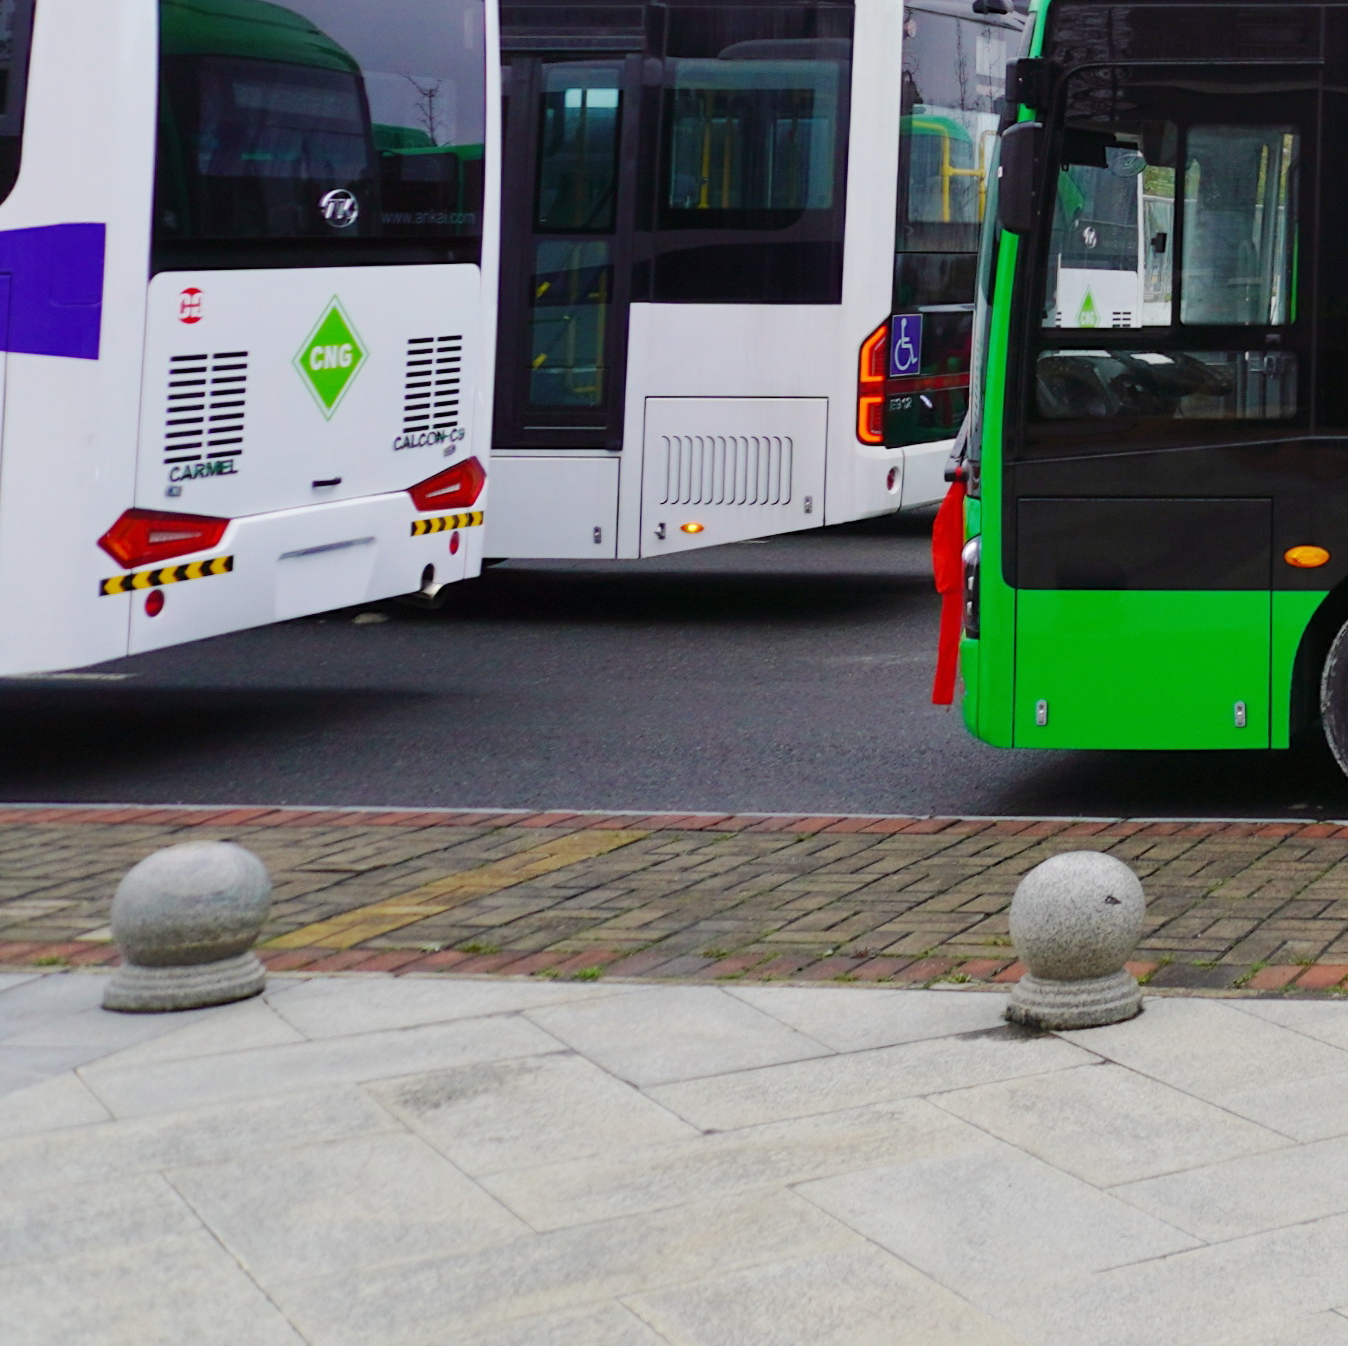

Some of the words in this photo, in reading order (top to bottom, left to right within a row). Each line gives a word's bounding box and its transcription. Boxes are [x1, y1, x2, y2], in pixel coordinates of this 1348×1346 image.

[380, 208, 475, 224] www.ankai.com
[310, 343, 353, 371] CNG
[169, 459, 239, 482] CARMEL
